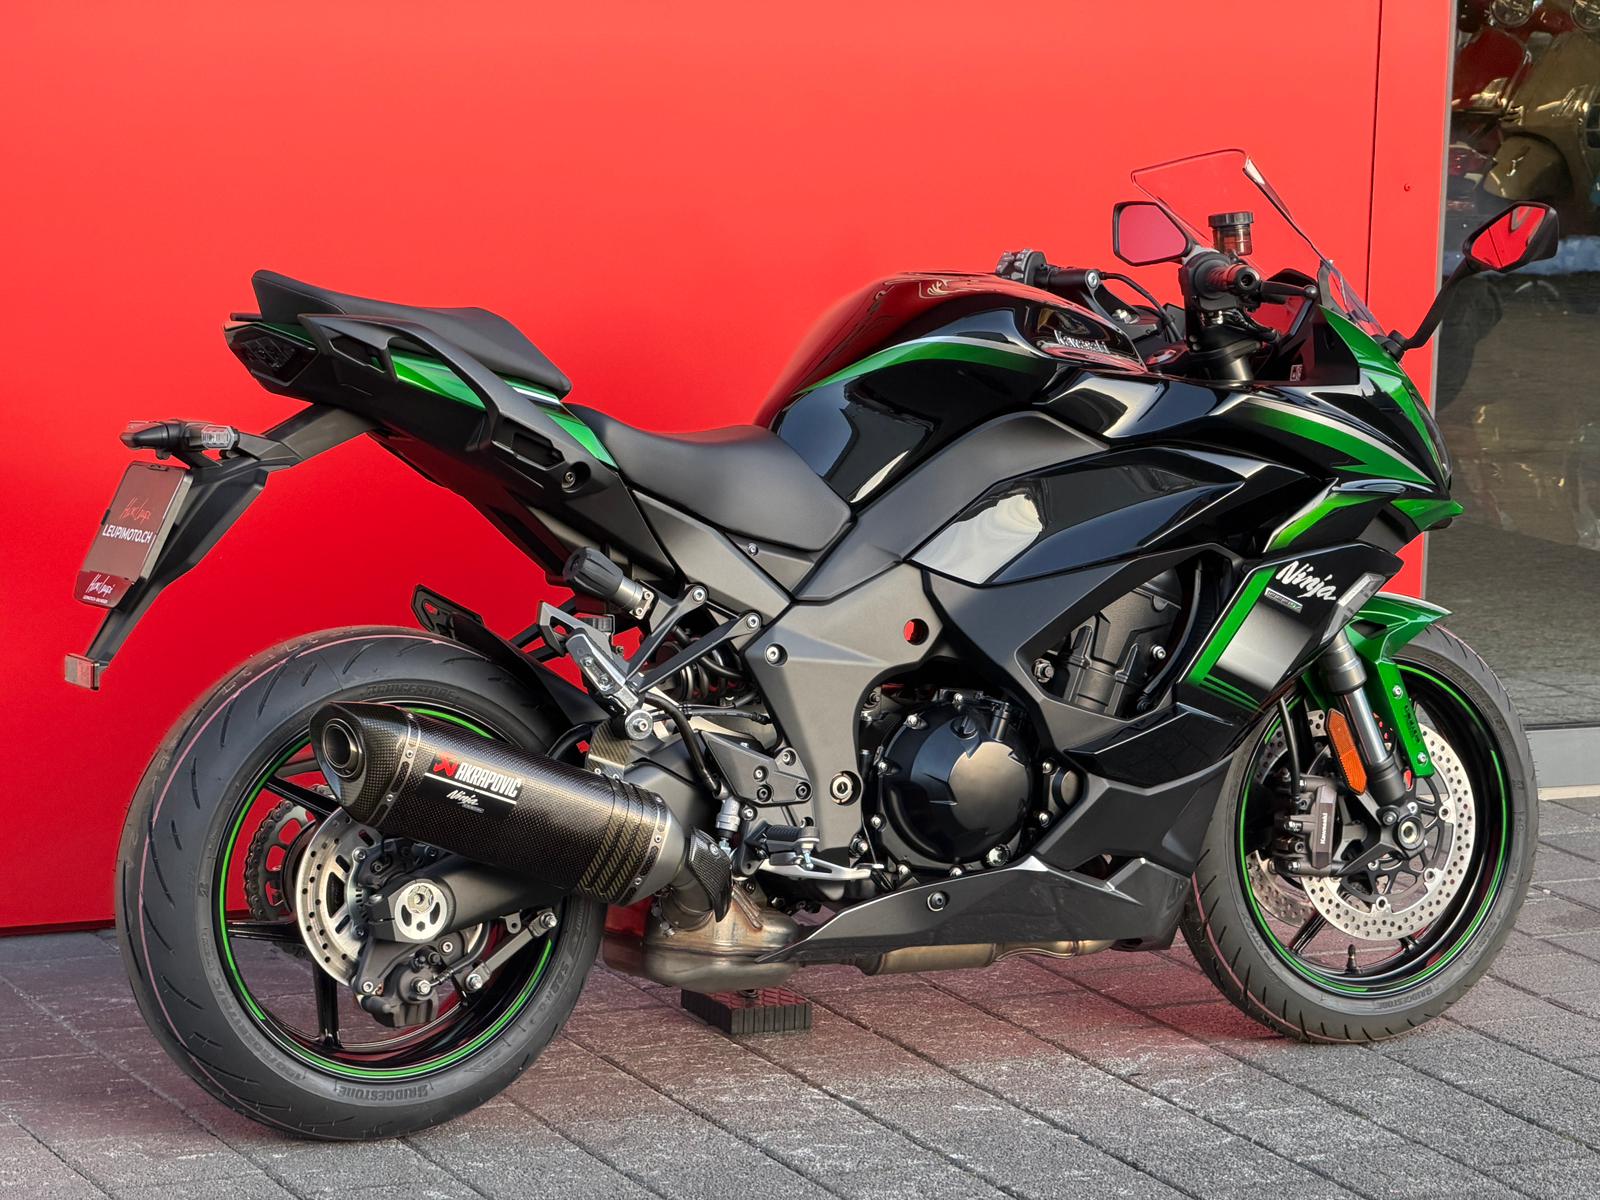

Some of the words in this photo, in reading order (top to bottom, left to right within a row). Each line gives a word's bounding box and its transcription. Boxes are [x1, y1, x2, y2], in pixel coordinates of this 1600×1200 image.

[1054, 329, 1111, 354] Kawasaki
[102, 523, 153, 544] LEUPIMOTO.CH
[1275, 560, 1338, 601] Ninja
[446, 789, 479, 806] Ninja
[1319, 812, 1328, 845] Kawasaki
[337, 1084, 428, 1101] BRIDGESTONE
